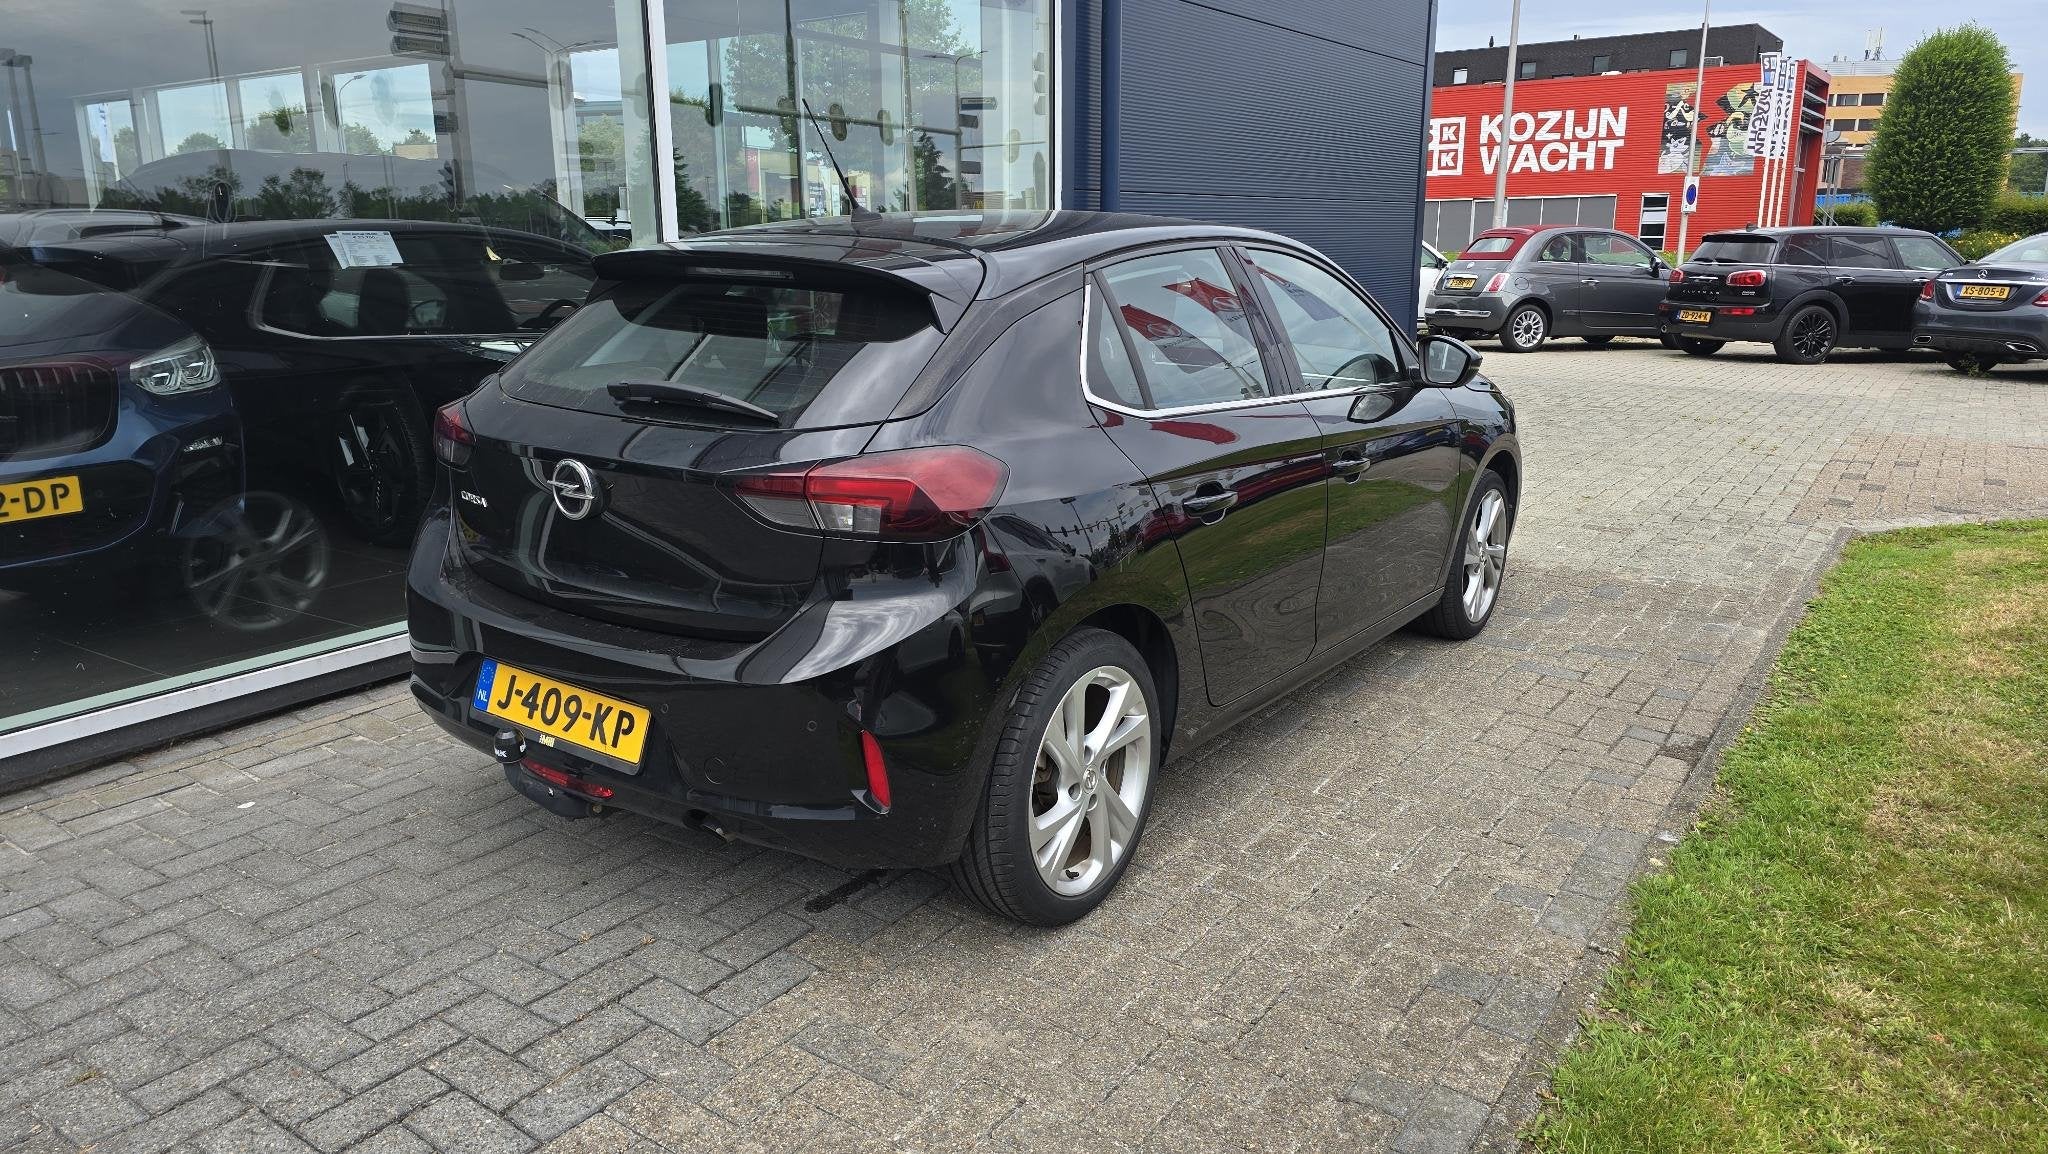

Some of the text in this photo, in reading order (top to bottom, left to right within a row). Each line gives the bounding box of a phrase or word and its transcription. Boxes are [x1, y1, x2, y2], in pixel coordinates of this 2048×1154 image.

[1479, 106, 1628, 144] KOZIJN
[1479, 139, 1625, 176] WACHT
[1963, 286, 2006, 296] XS-805-B
[1681, 311, 1709, 321] ZD-924-K
[477, 688, 488, 702] NL
[497, 674, 635, 749] J-409-KP
